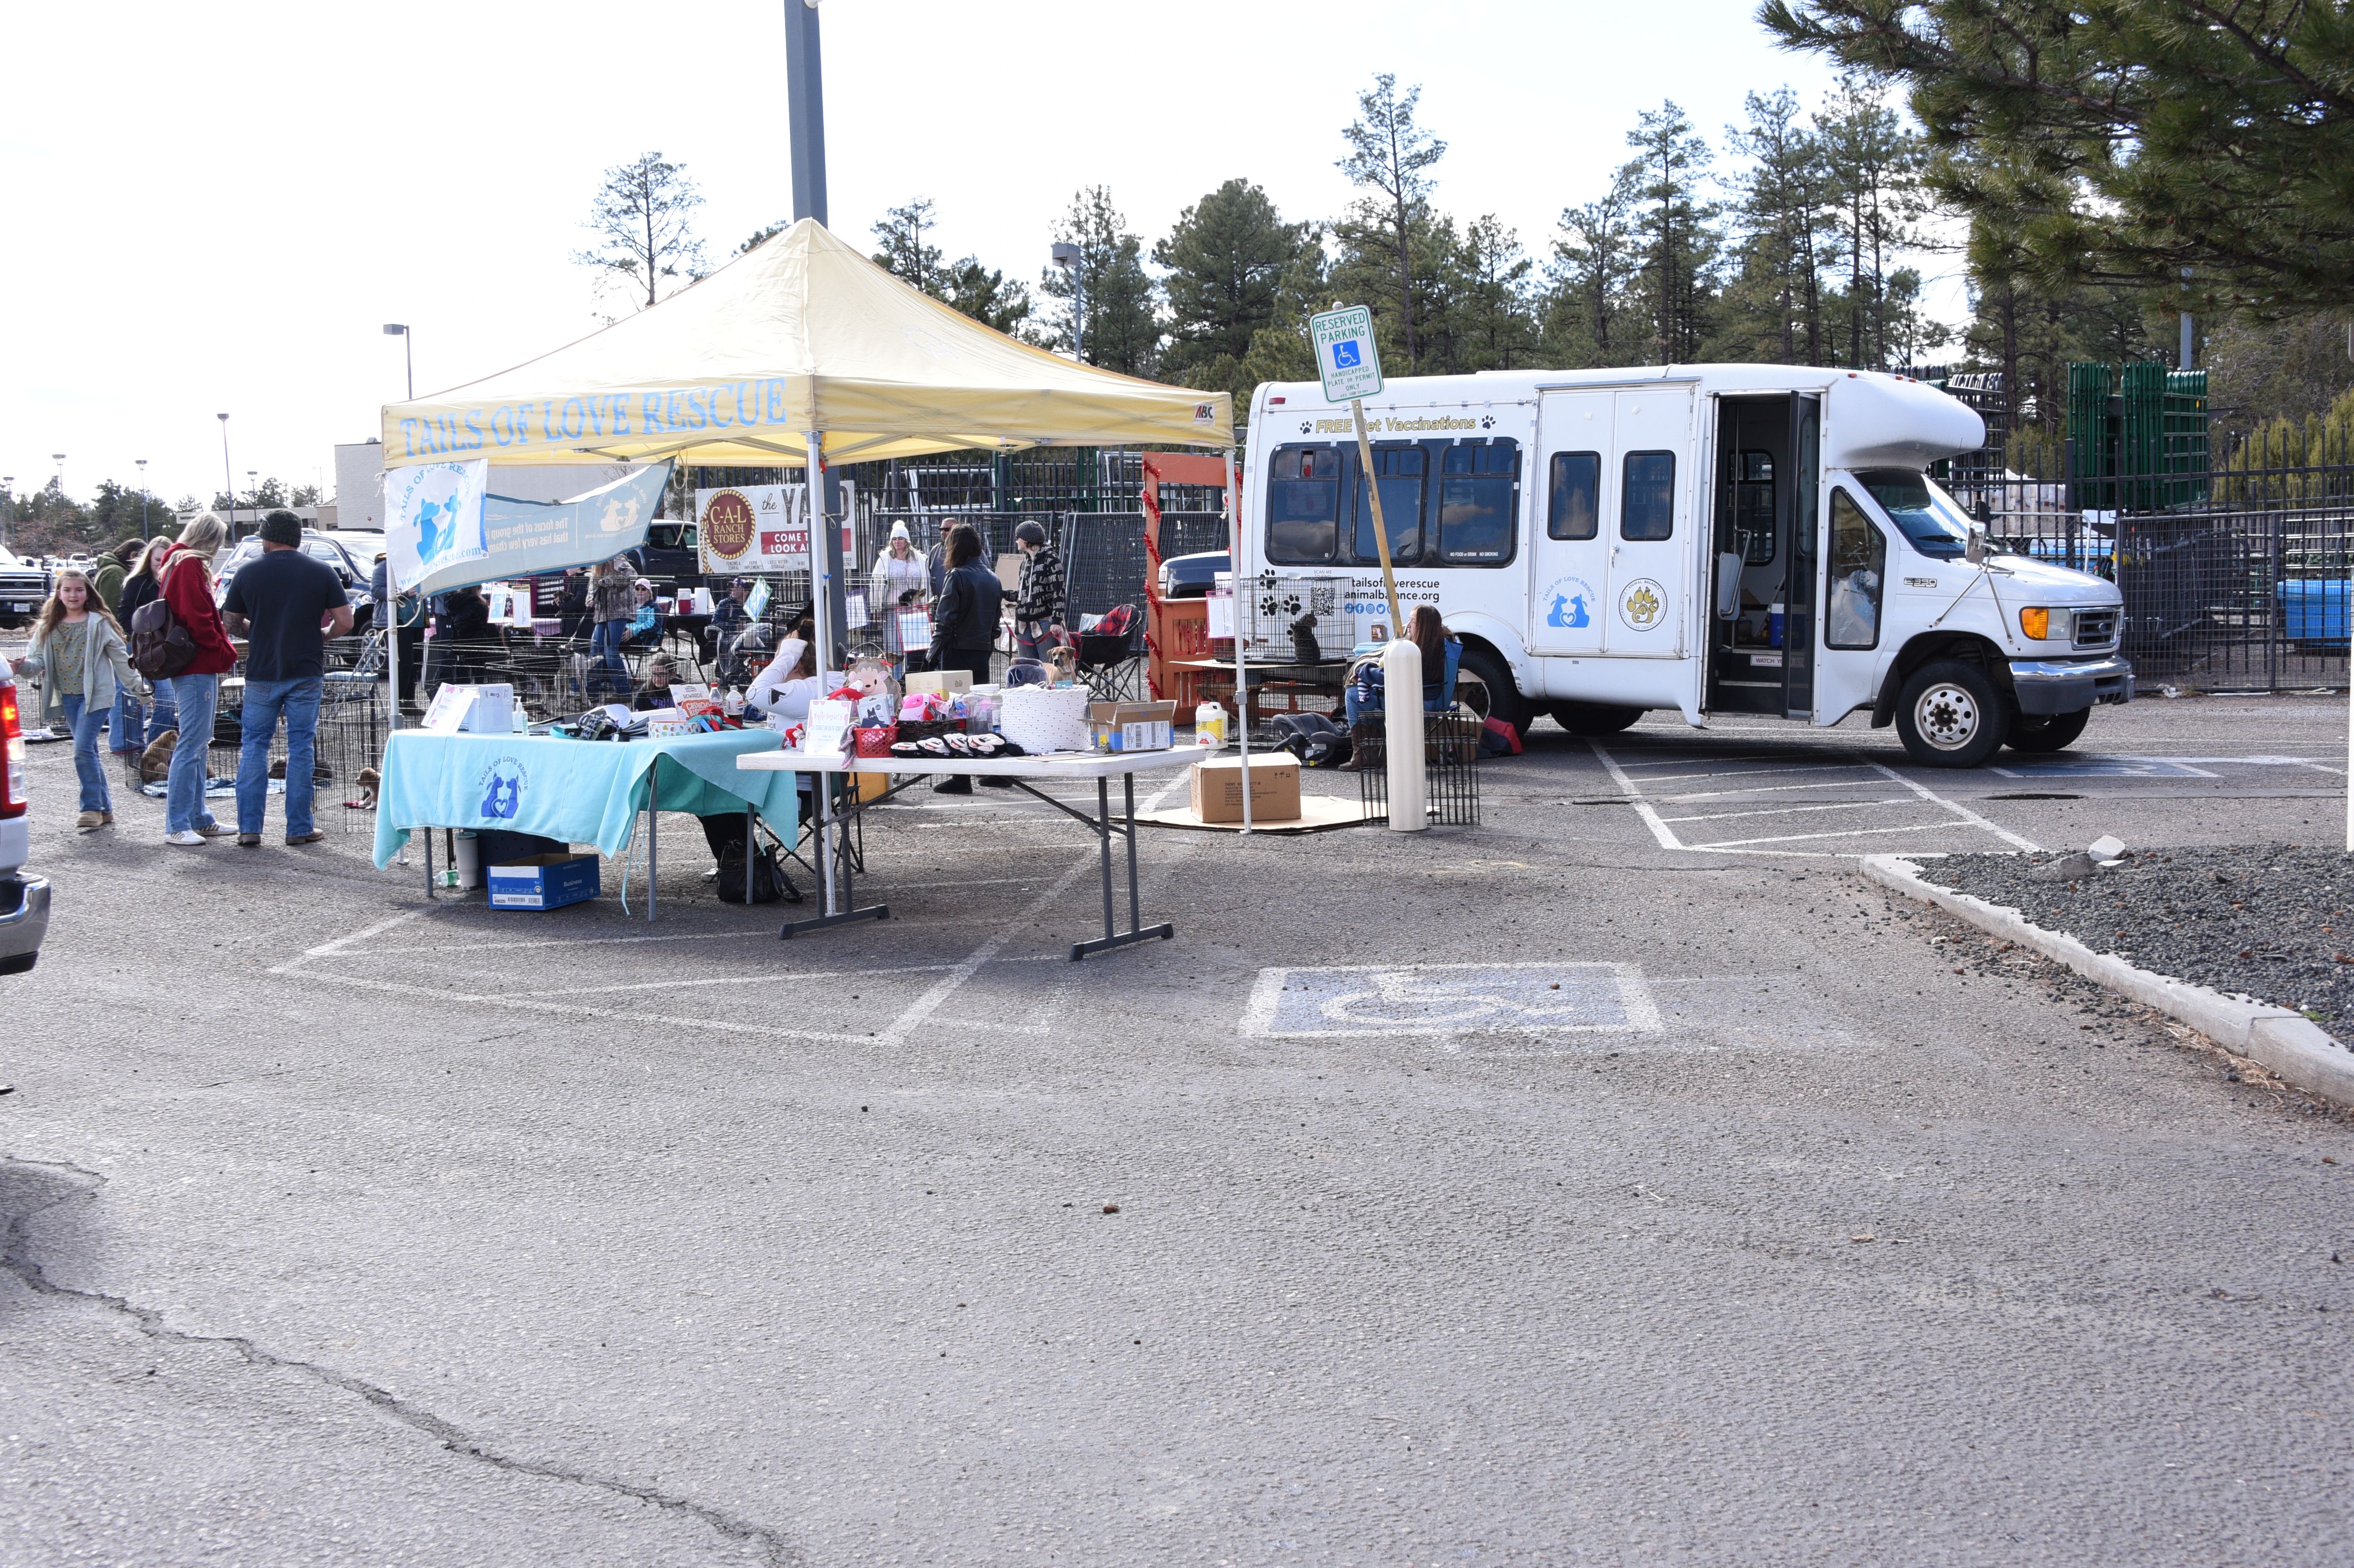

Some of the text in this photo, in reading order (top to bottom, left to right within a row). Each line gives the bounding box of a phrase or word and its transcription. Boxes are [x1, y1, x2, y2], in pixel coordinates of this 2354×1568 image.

[1316, 313, 1365, 332] RESERVED
[1320, 326, 1365, 344] PARKING
[1327, 378, 1344, 387] PLATE
[1355, 372, 1375, 381] PERMIT
[1331, 366, 1369, 378] HANDICAPPED
[400, 378, 787, 457] TAILS OF LOVE RESCUE
[1195, 406, 1213, 419] ABC
[1316, 416, 1476, 433] FREE et Vaccinations
[400, 486, 414, 521] TAILS
[414, 470, 425, 485] OF
[426, 463, 446, 473] LOVE
[761, 493, 777, 510] the
[710, 505, 747, 525] C-A-L
[714, 524, 744, 533] RANCH
[714, 533, 745, 544] STORES
[775, 533, 801, 542] COME
[770, 543, 797, 553] LOOK
[1543, 584, 1554, 602] TAILS
[1580, 580, 1595, 603] RESCUE
[1644, 580, 1660, 591] BALANCE
[1345, 590, 1440, 603] animalbaance.org
[479, 766, 493, 786] TAILS
[503, 756, 518, 765] LOVE
[518, 763, 528, 791] RESCUE
[564, 878, 582, 887] Business
